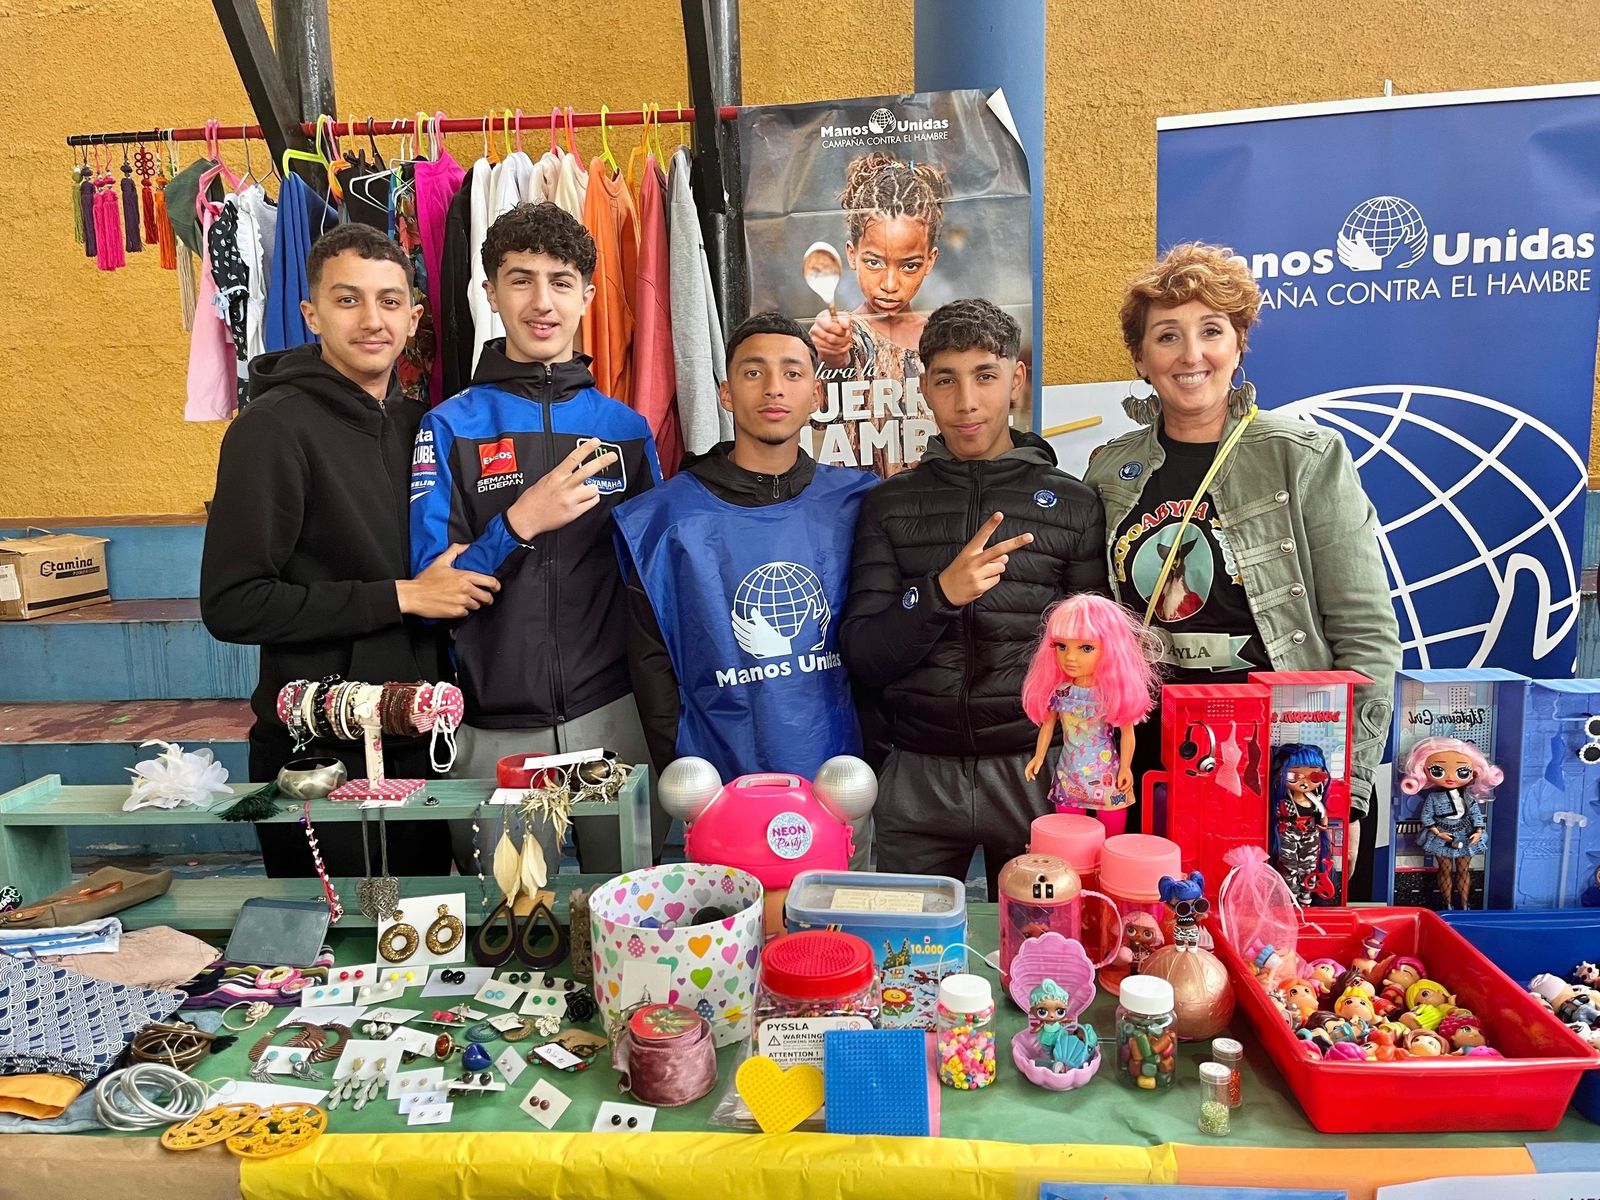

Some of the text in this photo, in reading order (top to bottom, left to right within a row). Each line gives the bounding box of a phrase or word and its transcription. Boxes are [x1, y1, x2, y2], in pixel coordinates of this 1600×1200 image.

[820, 118, 949, 138] Manos Unidas
[821, 131, 949, 149] CAMPAÑA CONTRA EL HAMBRE
[1432, 227, 1595, 266] Unidas
[1326, 277, 1442, 306] CONTRA
[1451, 274, 1478, 298] EL
[1486, 268, 1592, 296] HAMBRE
[814, 361, 857, 380] lara
[799, 419, 941, 467] AMB
[412, 444, 437, 466] LUBE
[477, 472, 524, 487] SEMAKIN
[478, 478, 524, 494] DI DEPAN
[592, 479, 623, 489] YAMAHA
[41, 557, 93, 577] Stamina
[715, 651, 842, 688] Manos Unidas
[772, 824, 807, 837] NEON
[777, 837, 802, 851] Party
[910, 943, 944, 955] 10.000
[767, 1022, 809, 1031] PYSSLA
